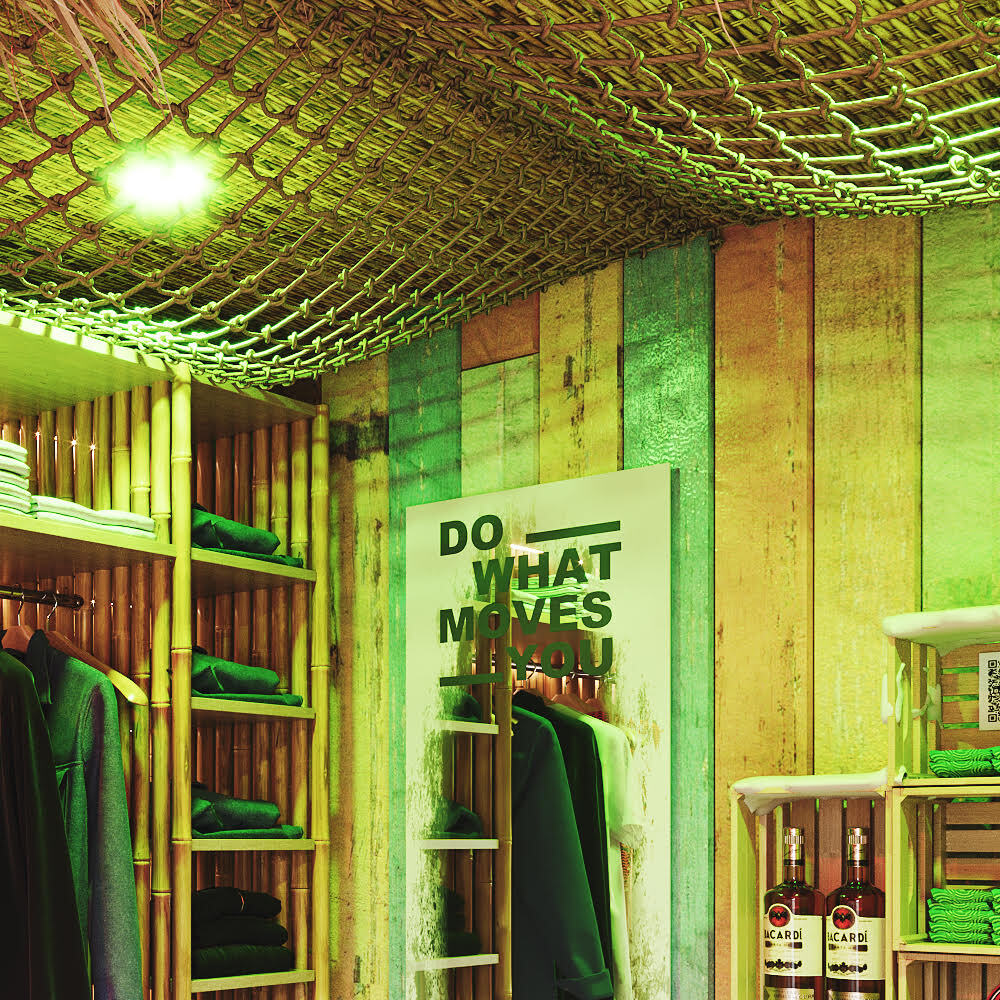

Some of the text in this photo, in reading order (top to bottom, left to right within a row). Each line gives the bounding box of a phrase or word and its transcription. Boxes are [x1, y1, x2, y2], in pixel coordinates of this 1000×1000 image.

[440, 514, 503, 556] DO
[472, 541, 621, 595] WHAT
[439, 590, 612, 643] MOVES
[506, 637, 613, 681] YOU
